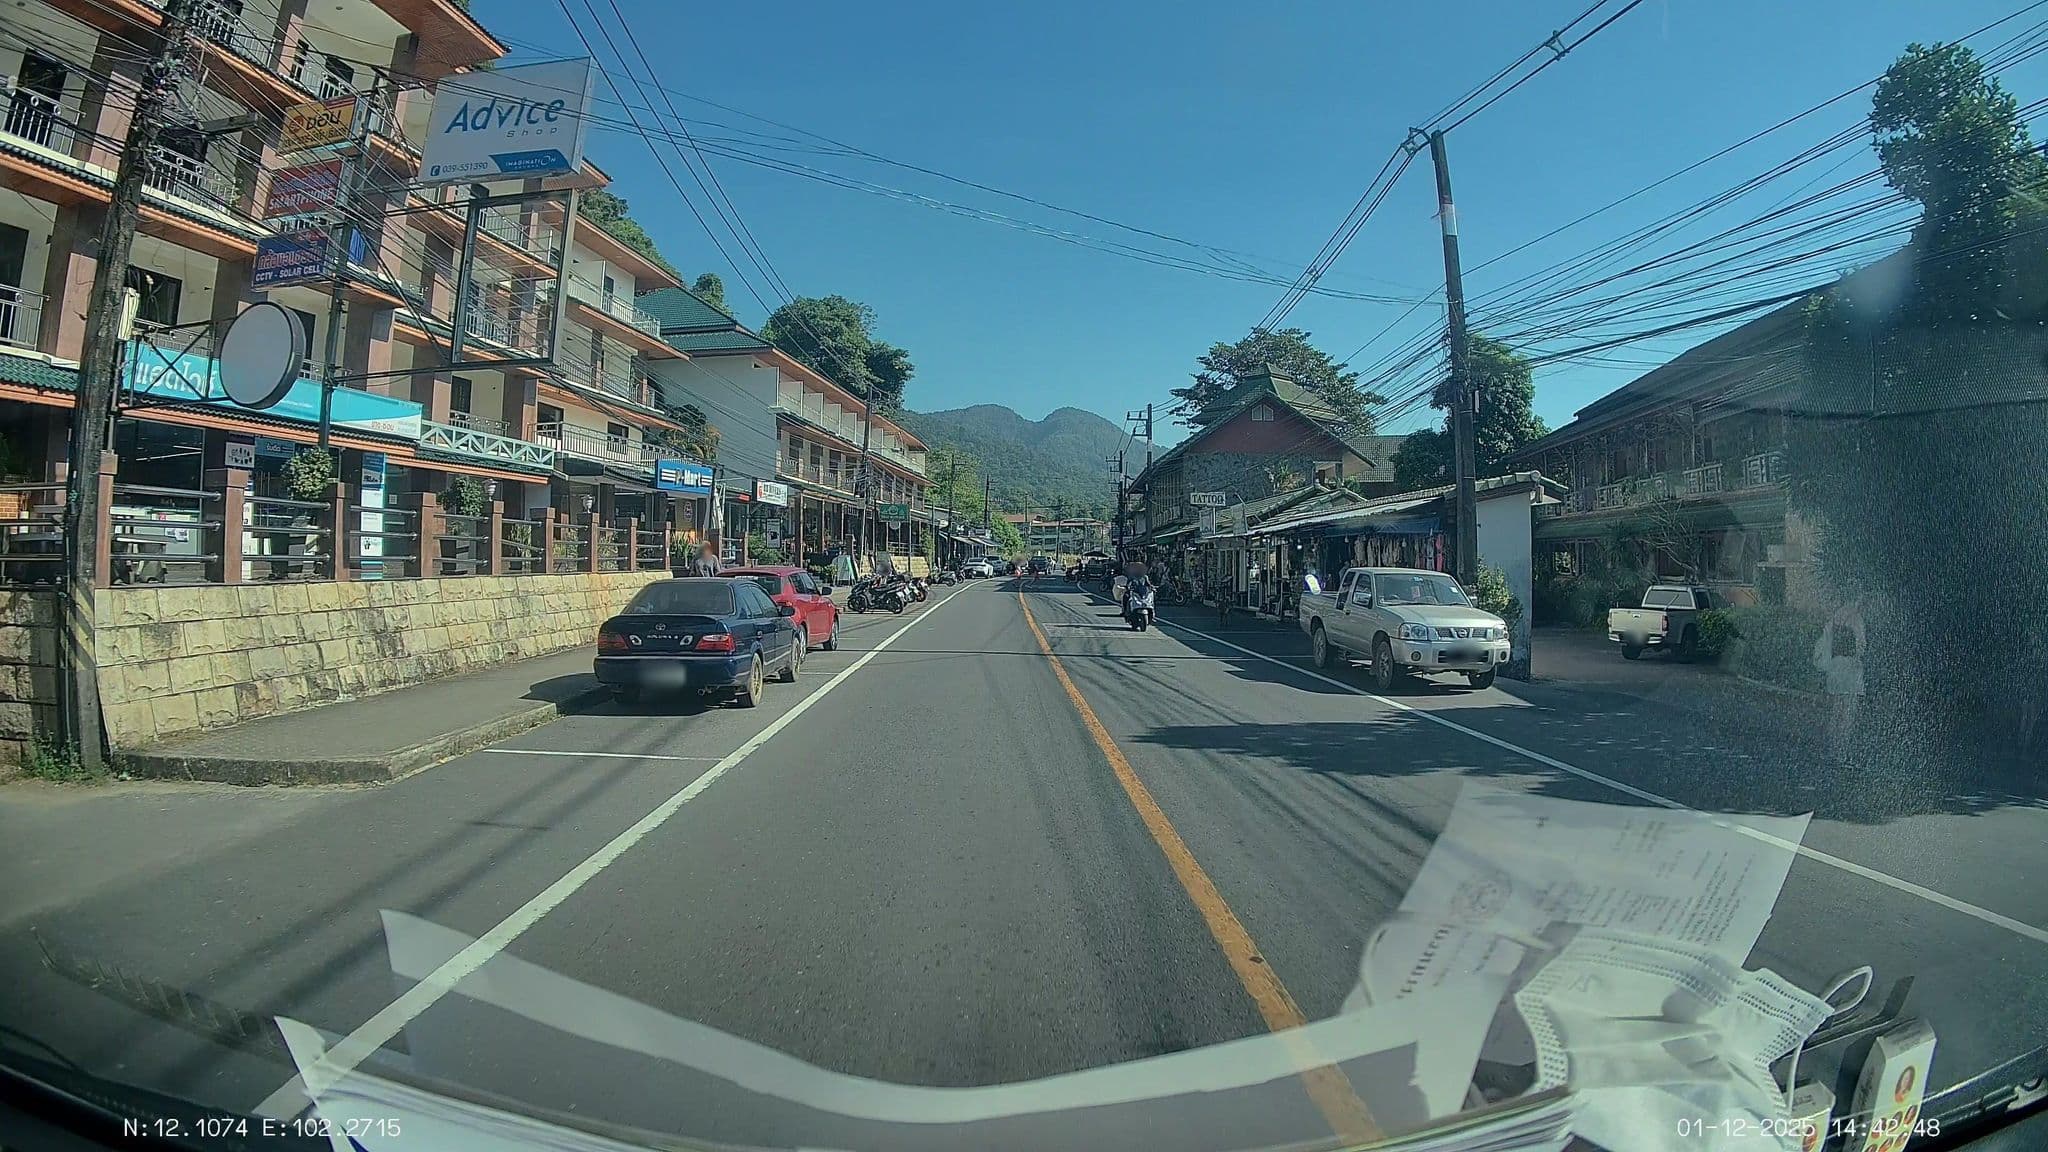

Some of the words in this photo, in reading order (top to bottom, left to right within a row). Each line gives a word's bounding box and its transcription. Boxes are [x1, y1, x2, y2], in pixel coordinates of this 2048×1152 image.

[444, 97, 565, 133] Advice
[506, 127, 558, 138] Shop
[255, 272, 274, 281] CCTV
[280, 267, 302, 278] SOLAR
[303, 264, 320, 273] CELL
[1192, 494, 1224, 504] TATTOO
